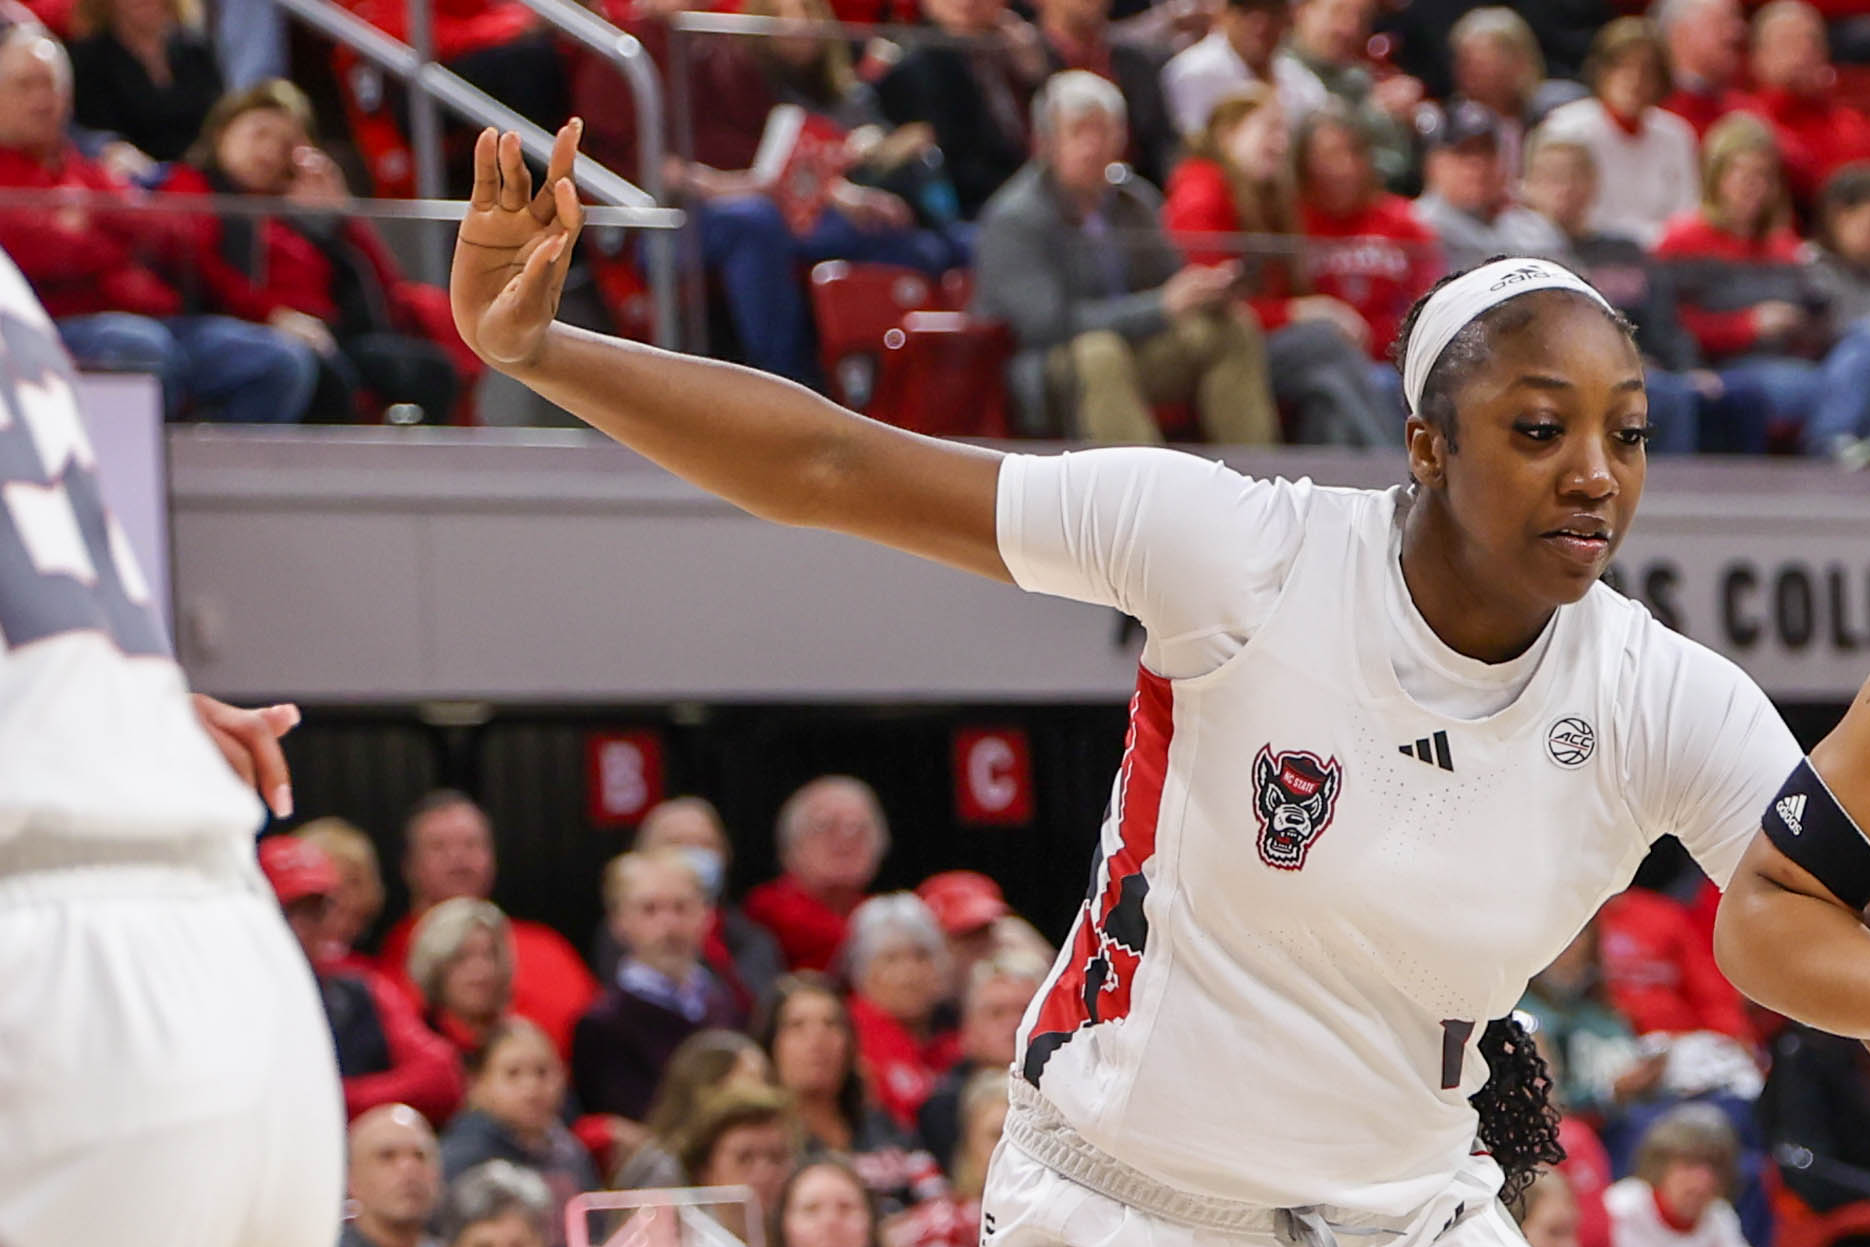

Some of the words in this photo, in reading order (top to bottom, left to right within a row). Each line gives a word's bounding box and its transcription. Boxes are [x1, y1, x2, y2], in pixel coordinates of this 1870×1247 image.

[1554, 732, 1594, 749] ACC
[602, 739, 647, 816] B
[967, 736, 1017, 812] C
[1292, 777, 1317, 794] STATE
